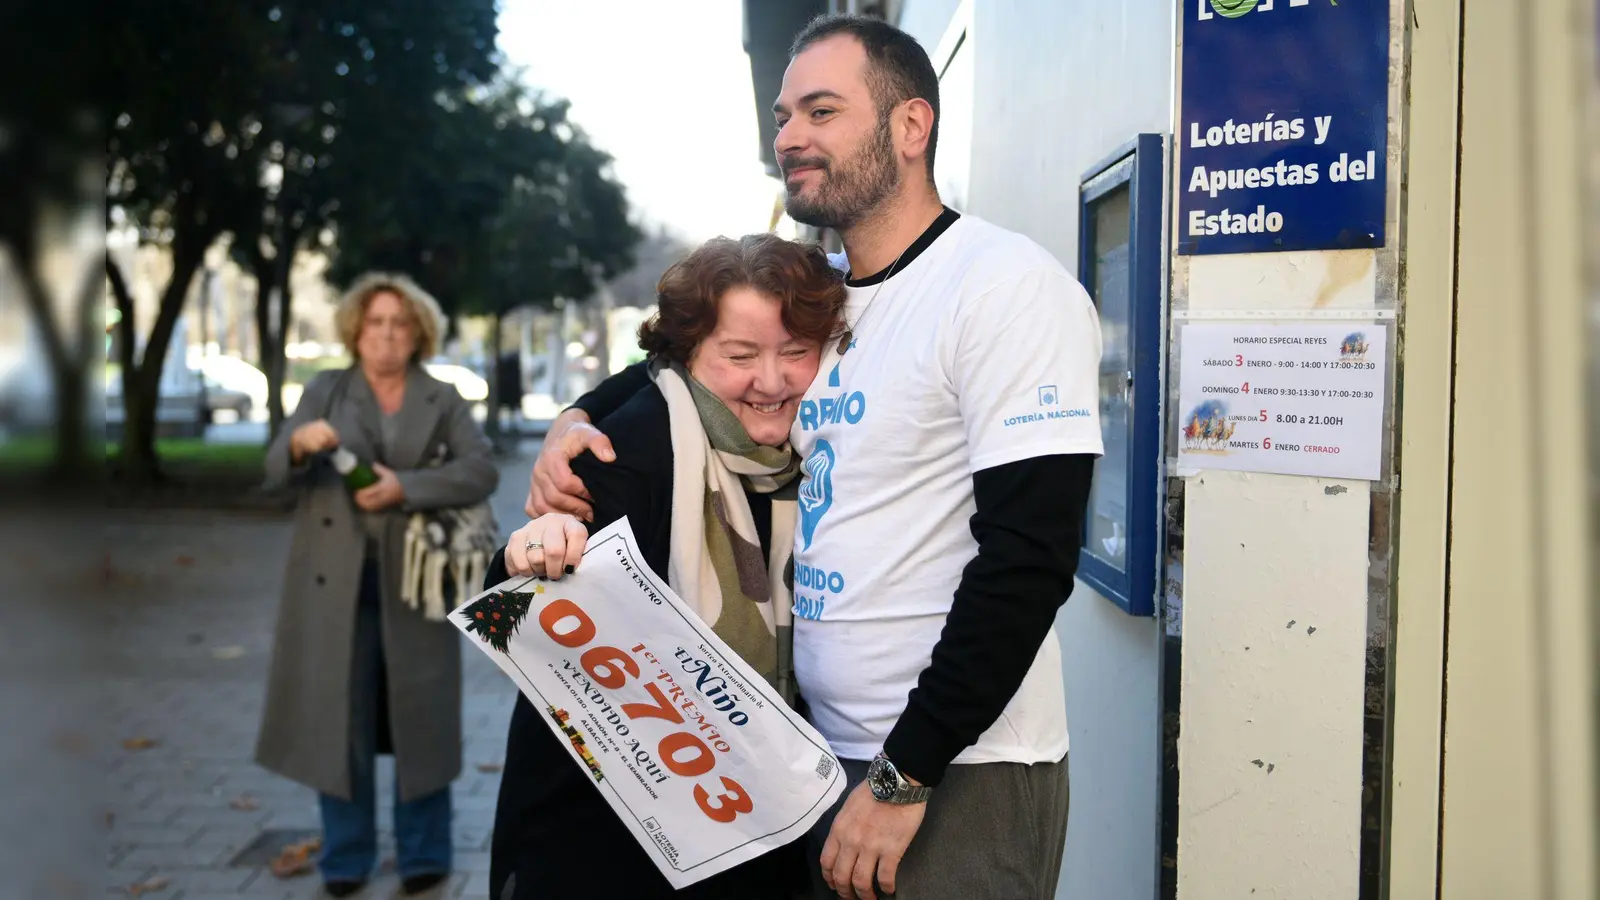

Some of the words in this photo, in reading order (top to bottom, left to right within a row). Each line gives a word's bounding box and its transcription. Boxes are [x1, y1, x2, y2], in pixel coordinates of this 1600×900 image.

[1190, 113, 1305, 148] Loterías
[1314, 115, 1332, 145] y
[1188, 159, 1319, 198] Apuestas
[1328, 150, 1376, 183] del
[1188, 204, 1284, 236] Estado
[1304, 337, 1327, 345] REYES
[1202, 358, 1233, 367] SÁBADO
[1235, 354, 1243, 367] 3
[1247, 360, 1272, 368] ENERO
[1330, 361, 1376, 370] 17:00-20:30
[1202, 386, 1239, 394] DOMINGO
[1241, 382, 1249, 394] 4
[1280, 389, 1319, 397] 9:30-13:30
[1321, 389, 1326, 397] Y
[1328, 390, 1373, 398] 17:00-20:30
[1047, 409, 1091, 419] NACIONAL
[1260, 410, 1267, 422] 5
[1276, 414, 1297, 423] 8.00
[1308, 416, 1343, 426] 21.00H
[1229, 441, 1259, 449] MARTES
[1263, 438, 1271, 449] 6
[1304, 445, 1340, 454] CERRADO
[616, 548, 623, 556] 6
[620, 556, 634, 572] DE
[632, 572, 662, 605] ENERO
[682, 660, 749, 726] Niño
[697, 644, 717, 664] Sorteo
[718, 662, 756, 703] Extraordinario
[756, 701, 764, 709] de
[539, 598, 753, 823] 06703
[632, 642, 660, 664] 1er
[657, 668, 730, 752] PREMIO
[554, 670, 571, 689] VENTA
[621, 755, 629, 763] EL
[627, 763, 658, 800] SEMBRADOR
[562, 658, 630, 736] VENDIDO
[624, 738, 670, 784] AQUÍ
[581, 719, 609, 753] ALBACETE
[654, 834, 679, 866] NACIONAL
